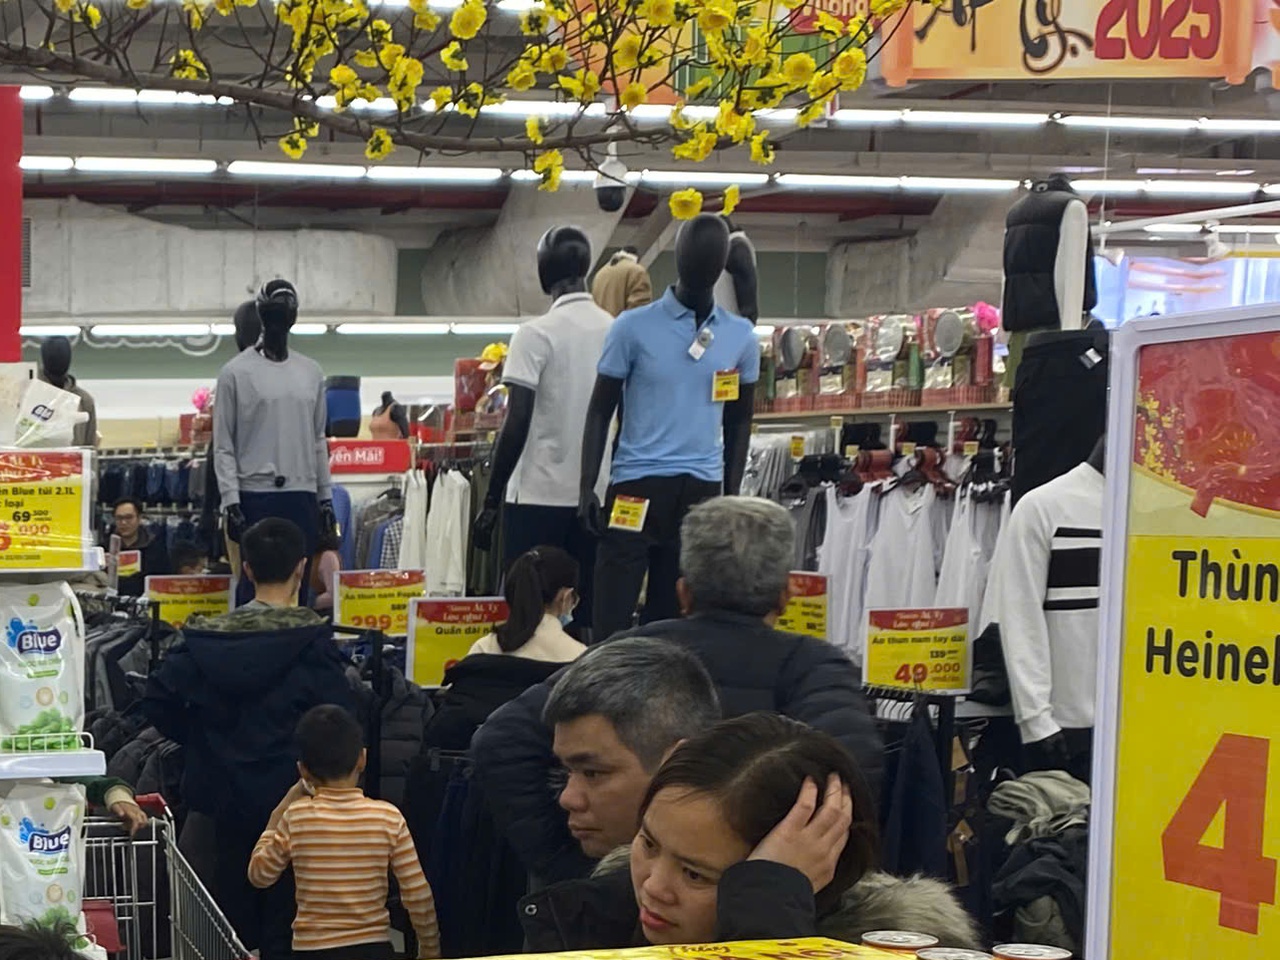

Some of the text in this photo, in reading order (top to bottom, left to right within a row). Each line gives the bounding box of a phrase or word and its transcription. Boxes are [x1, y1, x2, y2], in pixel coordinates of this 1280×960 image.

[12, 486, 35, 495] Blue
[38, 486, 53, 495] túi
[4, 499, 24, 509] loại
[12, 511, 31, 522] 69
[1172, 549, 1280, 603] Thùn
[21, 632, 58, 649] Blue
[1145, 626, 1280, 687] Heine
[894, 662, 928, 684] 49
[32, 830, 70, 850] Blue
[1160, 732, 1278, 936] 4
